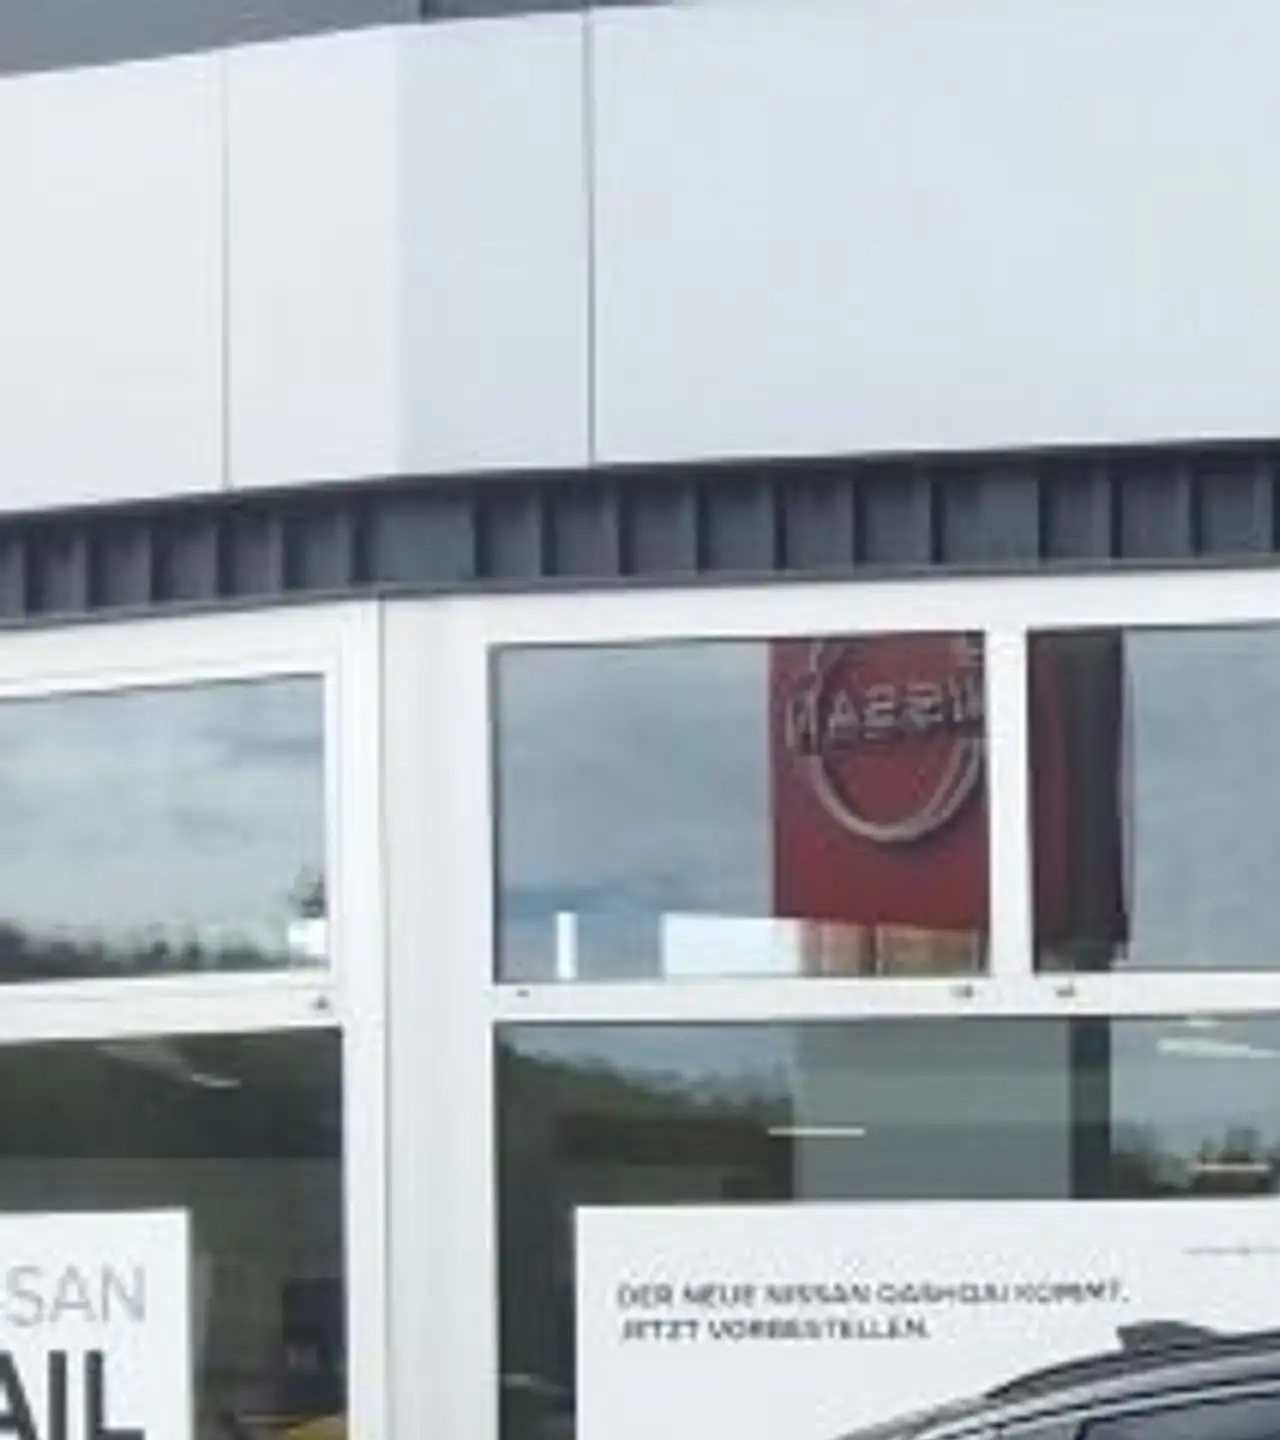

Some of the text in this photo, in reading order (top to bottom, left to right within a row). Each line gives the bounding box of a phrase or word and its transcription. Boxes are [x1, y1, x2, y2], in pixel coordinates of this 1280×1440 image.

[0, 1265, 146, 1326] SAN
[616, 1280, 674, 1308] DER
[622, 1317, 699, 1342] JETZT
